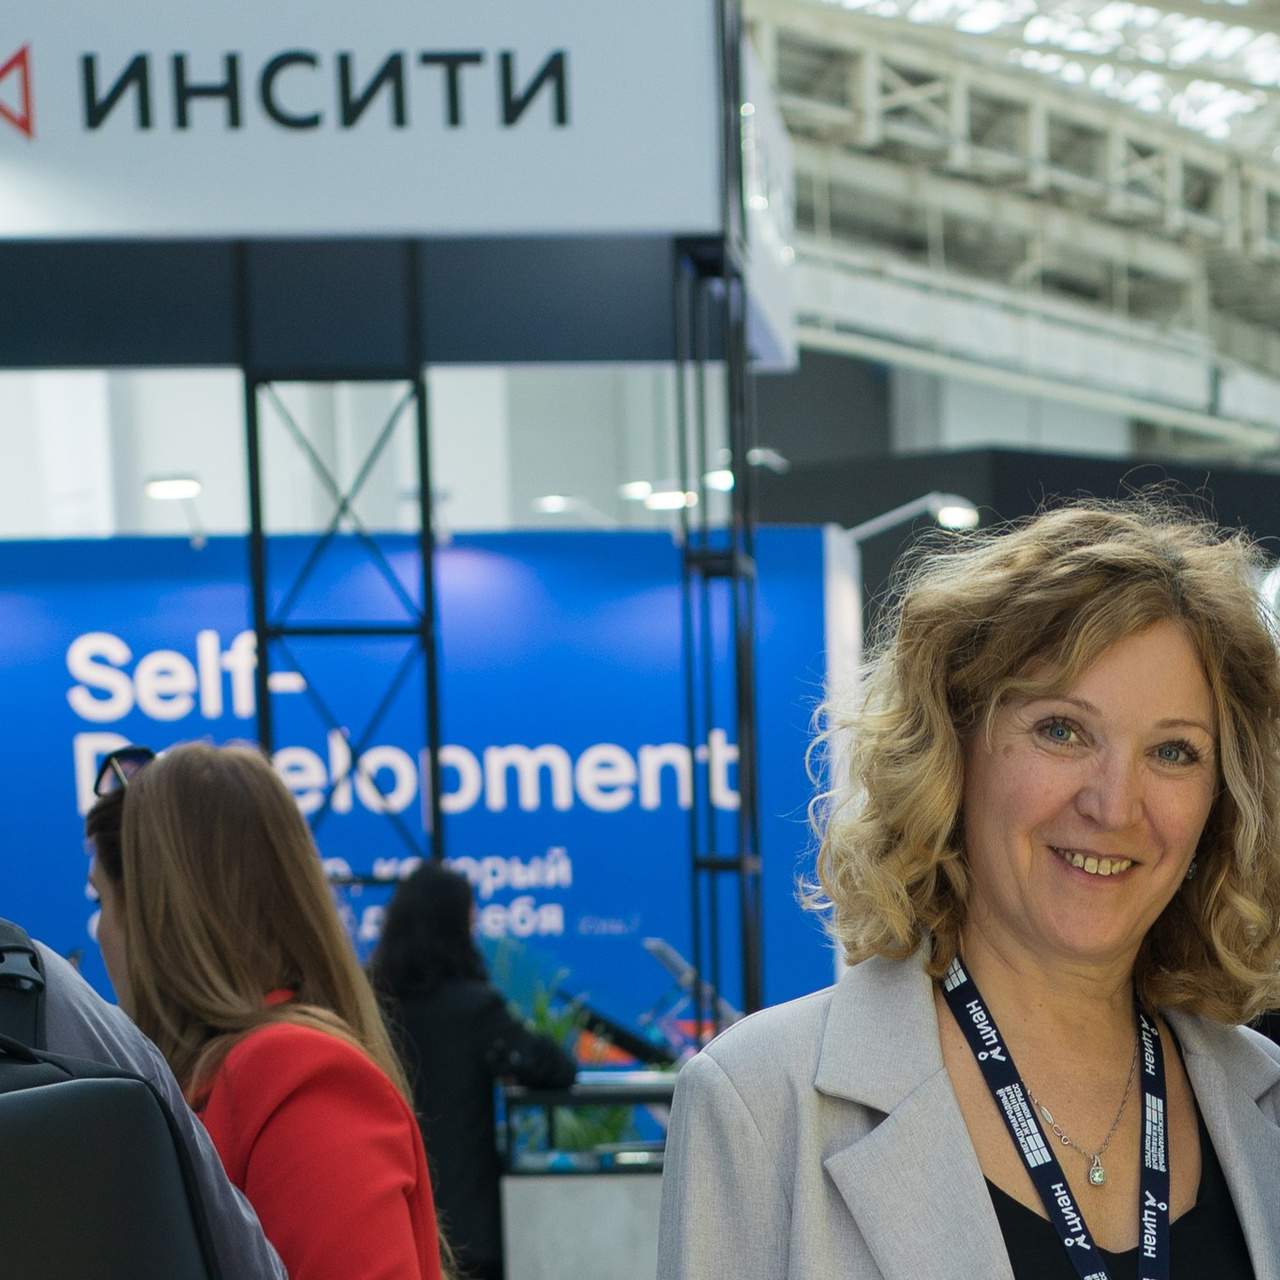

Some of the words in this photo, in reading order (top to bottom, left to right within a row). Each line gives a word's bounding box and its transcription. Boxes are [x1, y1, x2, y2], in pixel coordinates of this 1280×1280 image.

[81, 49, 571, 131] ИНСИТИ
[66, 629, 306, 723] Self-
[73, 726, 741, 834] Delopment
[966, 999, 998, 1048] циан
[1051, 1183, 1083, 1233] циан
[1142, 1209, 1157, 1258] циан
